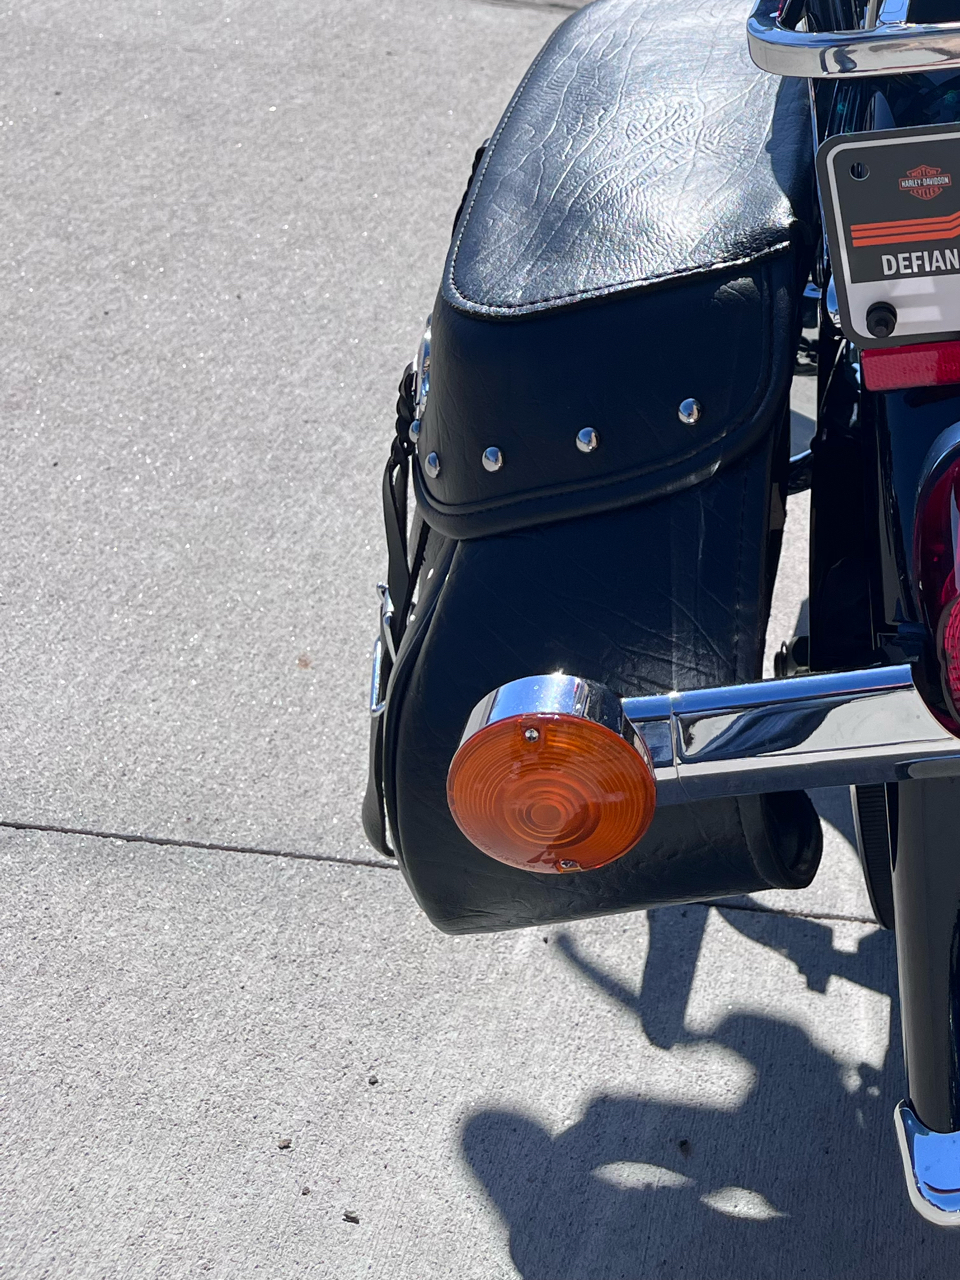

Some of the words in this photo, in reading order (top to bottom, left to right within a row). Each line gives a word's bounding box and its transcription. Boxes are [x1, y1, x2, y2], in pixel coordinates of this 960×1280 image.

[911, 167, 937, 176] MOTOR
[901, 176, 949, 187] HARLEY-DAVIDSON
[913, 186, 939, 198] CYCLES
